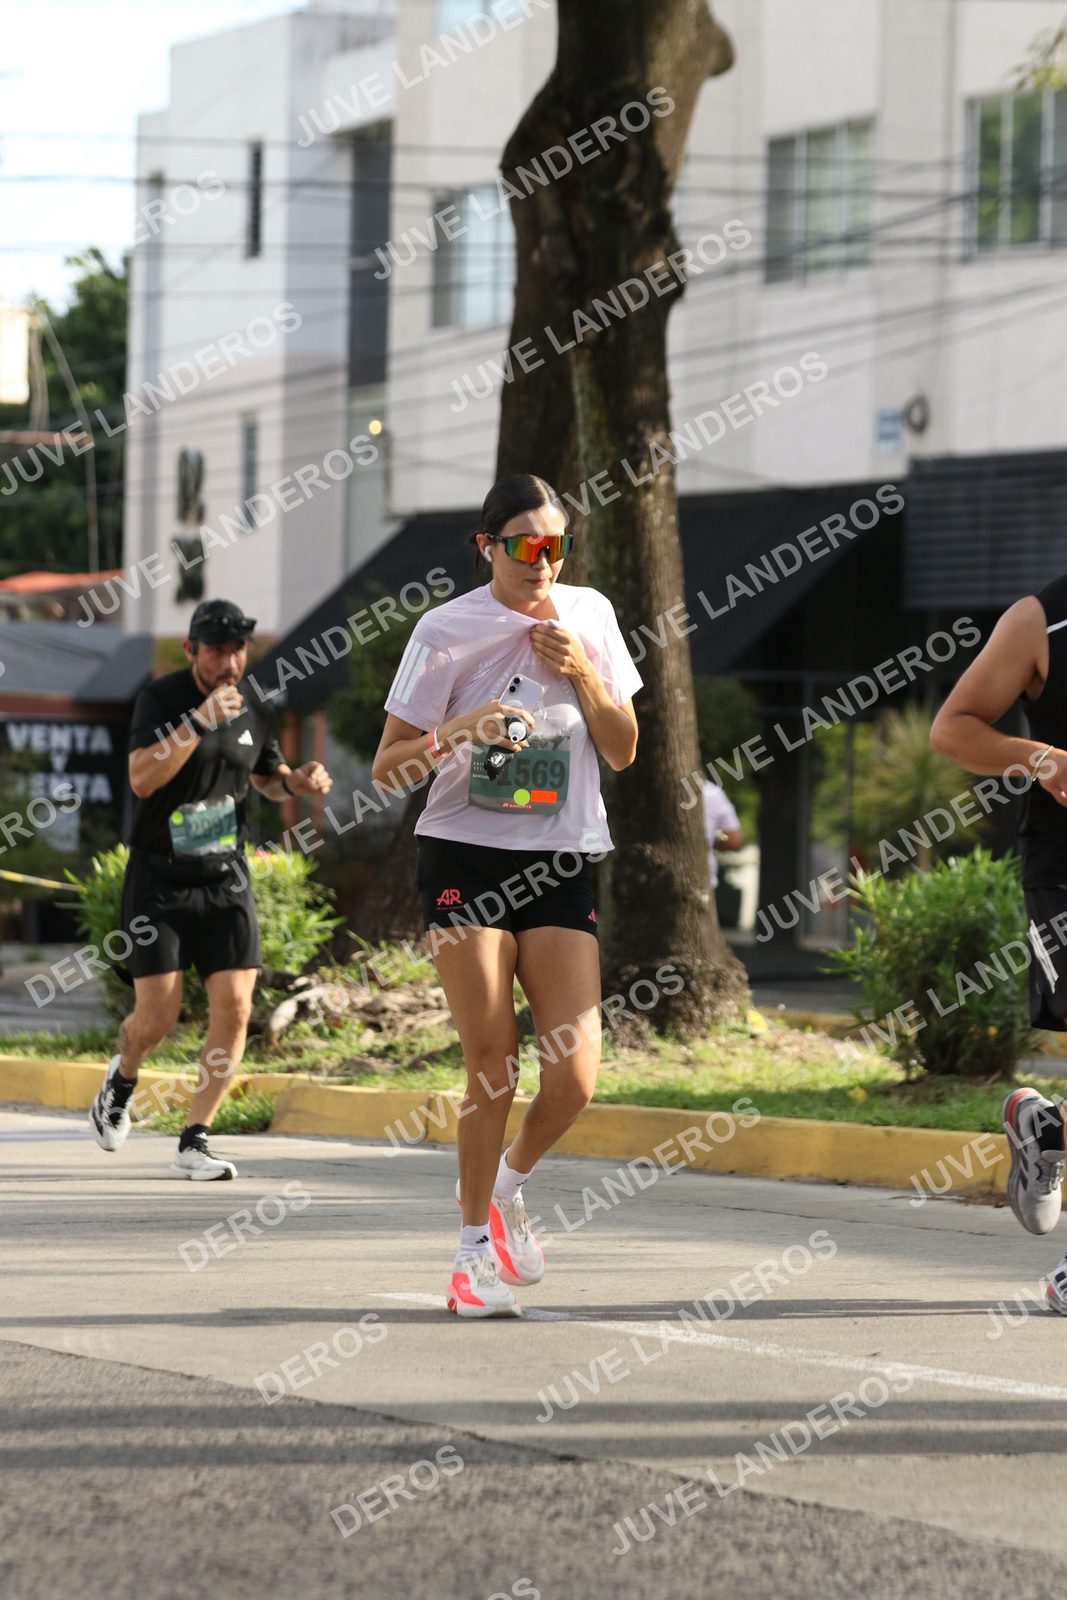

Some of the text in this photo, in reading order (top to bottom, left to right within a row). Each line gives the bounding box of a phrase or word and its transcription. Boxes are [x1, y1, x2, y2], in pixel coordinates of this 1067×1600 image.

[7, 723, 112, 755] VENTA
[16, 772, 112, 804] ENTA
[436, 888, 463, 906] AR
